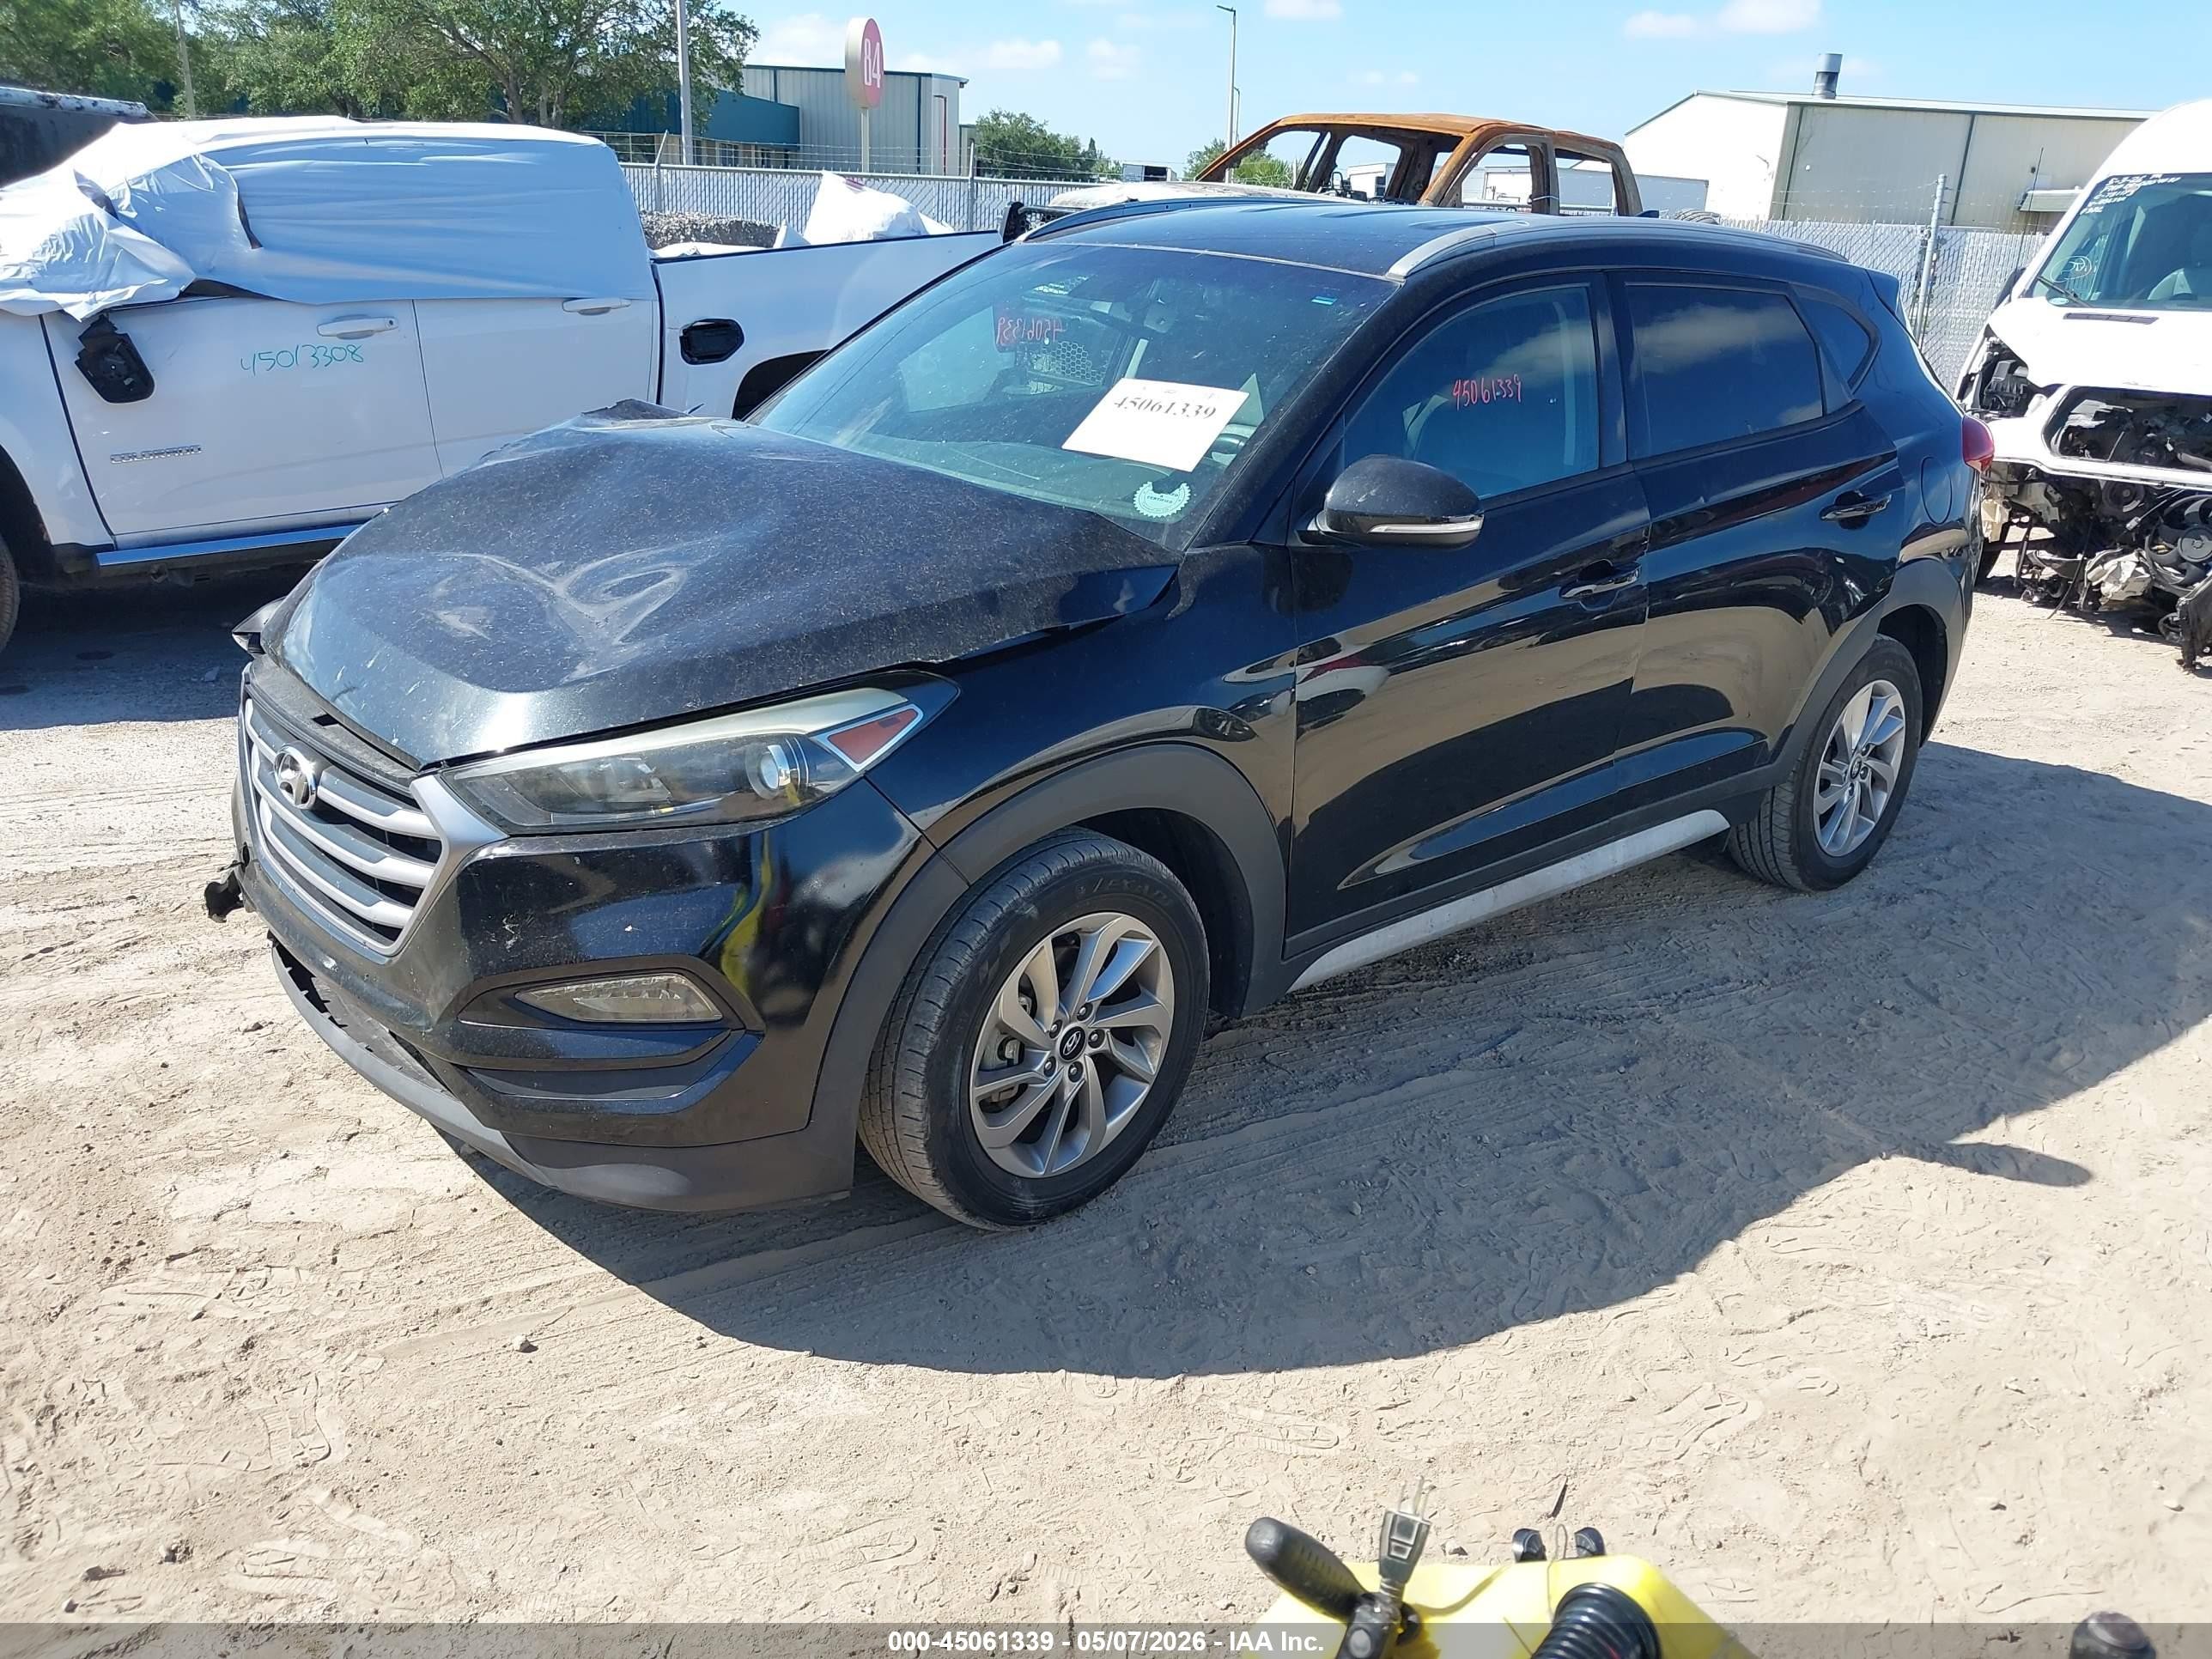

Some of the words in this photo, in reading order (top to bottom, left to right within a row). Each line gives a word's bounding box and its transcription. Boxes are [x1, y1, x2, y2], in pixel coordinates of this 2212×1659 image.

[864, 37, 881, 88] 84
[240, 344, 364, 376] 45013308
[1114, 396, 1217, 419] 45061339
[1452, 374, 1522, 410] 45061339
[110, 445, 202, 464] COLORADO
